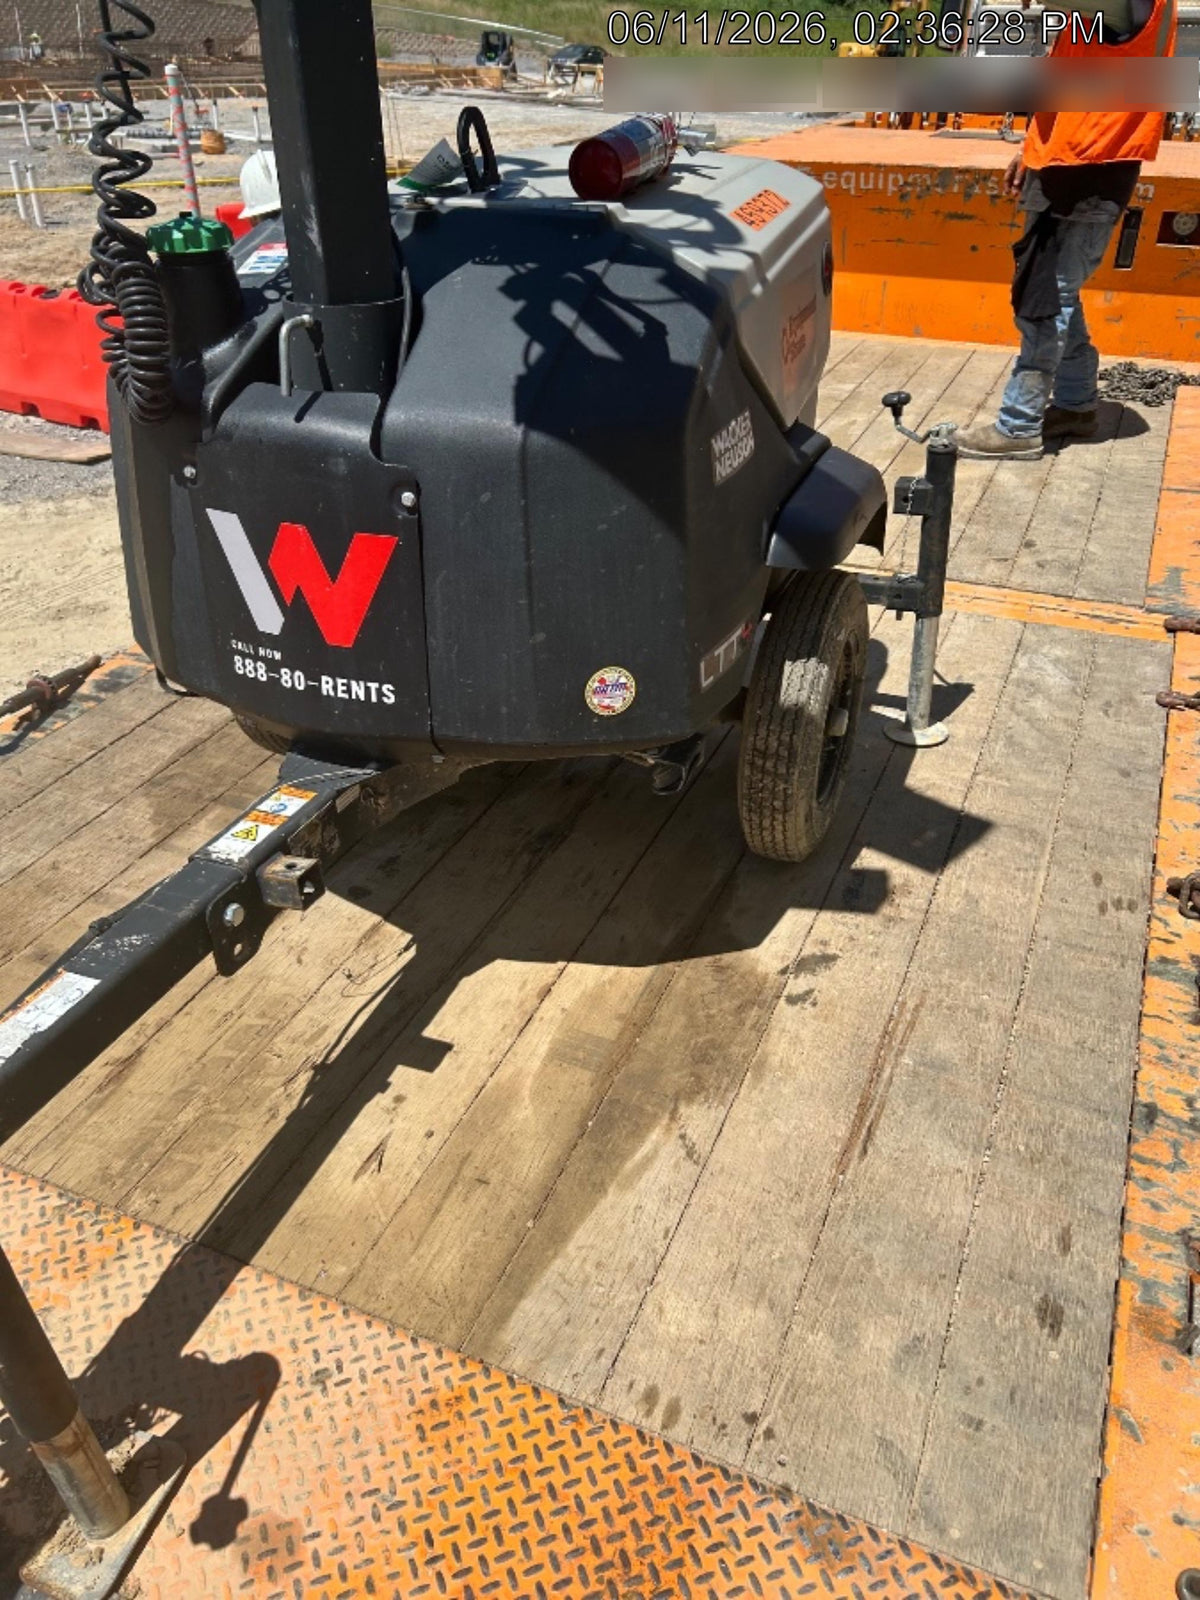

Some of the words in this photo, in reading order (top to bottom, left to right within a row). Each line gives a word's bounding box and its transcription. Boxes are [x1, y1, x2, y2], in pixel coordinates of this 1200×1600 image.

[231, 639, 254, 655] CALL
[258, 647, 282, 661] NOW
[233, 655, 396, 704] 888-80-RENTS
